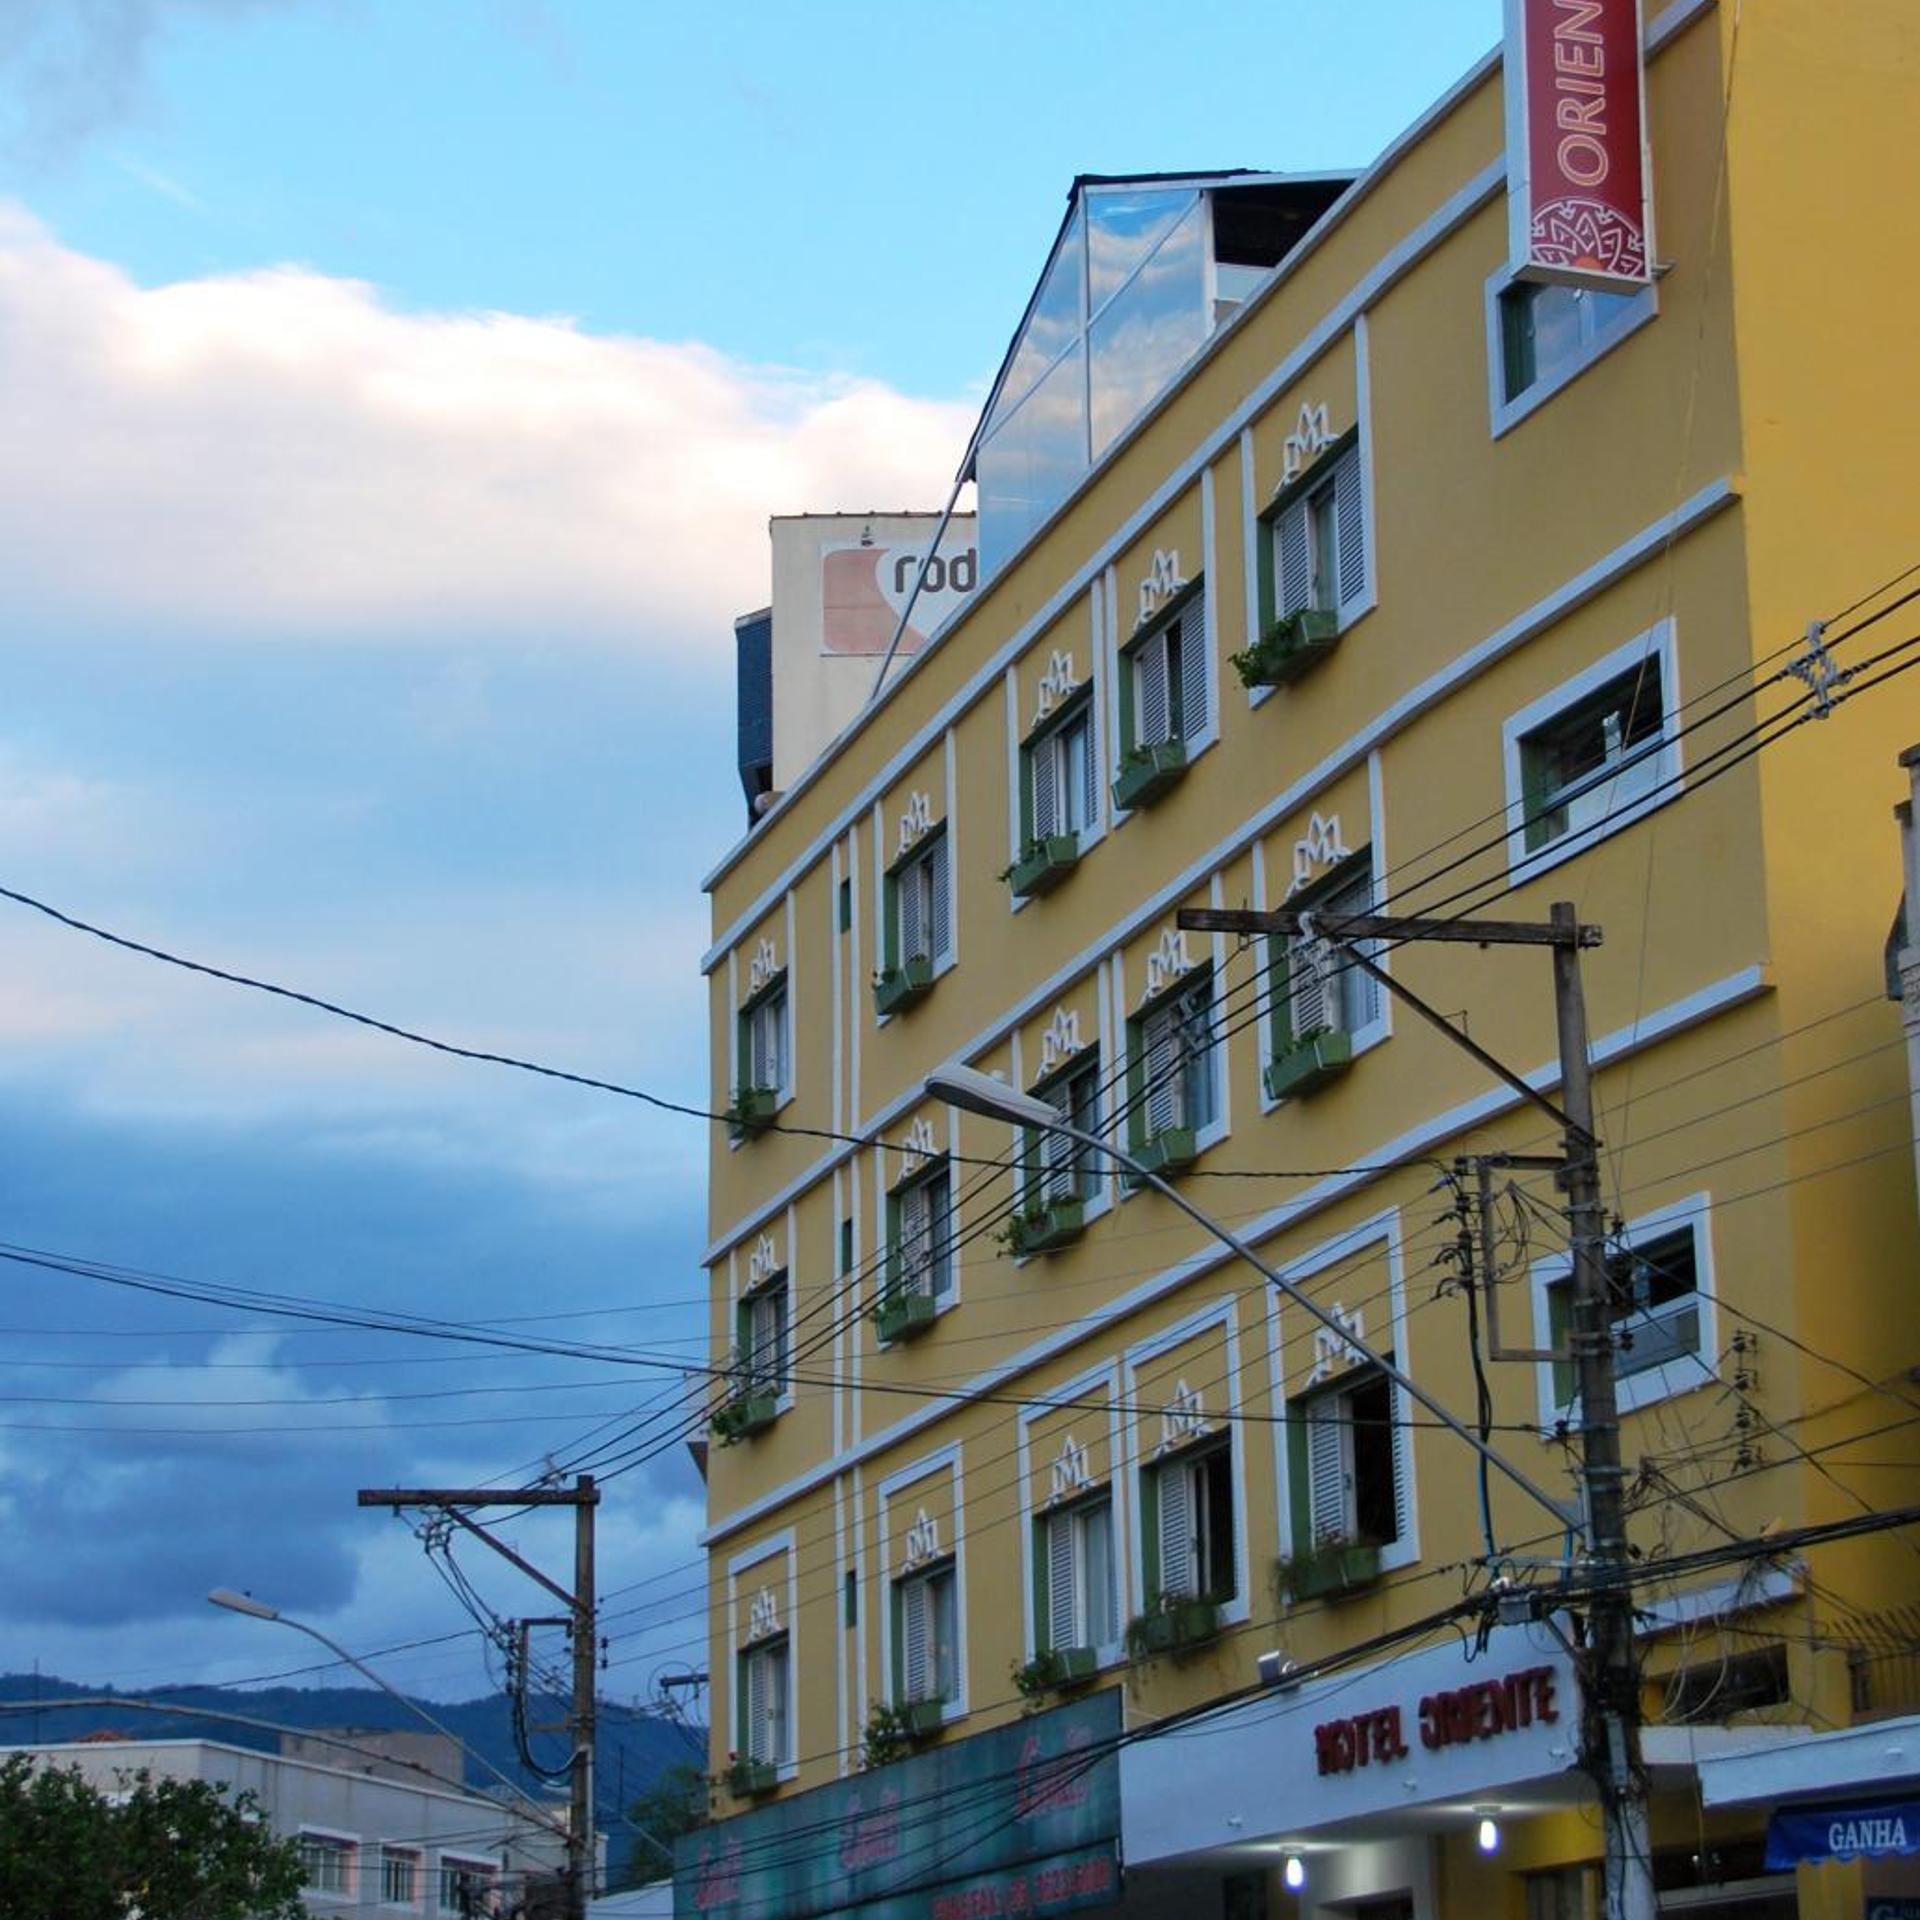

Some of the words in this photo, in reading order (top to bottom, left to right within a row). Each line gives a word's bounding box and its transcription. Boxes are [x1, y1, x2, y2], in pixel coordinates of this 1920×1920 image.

[1553, 0, 1608, 187] ORIEN
[1314, 1705, 1409, 1776] HOTEL
[1418, 1665, 1560, 1749] ORIENTE
[1828, 1817, 1907, 1852] GANHA
